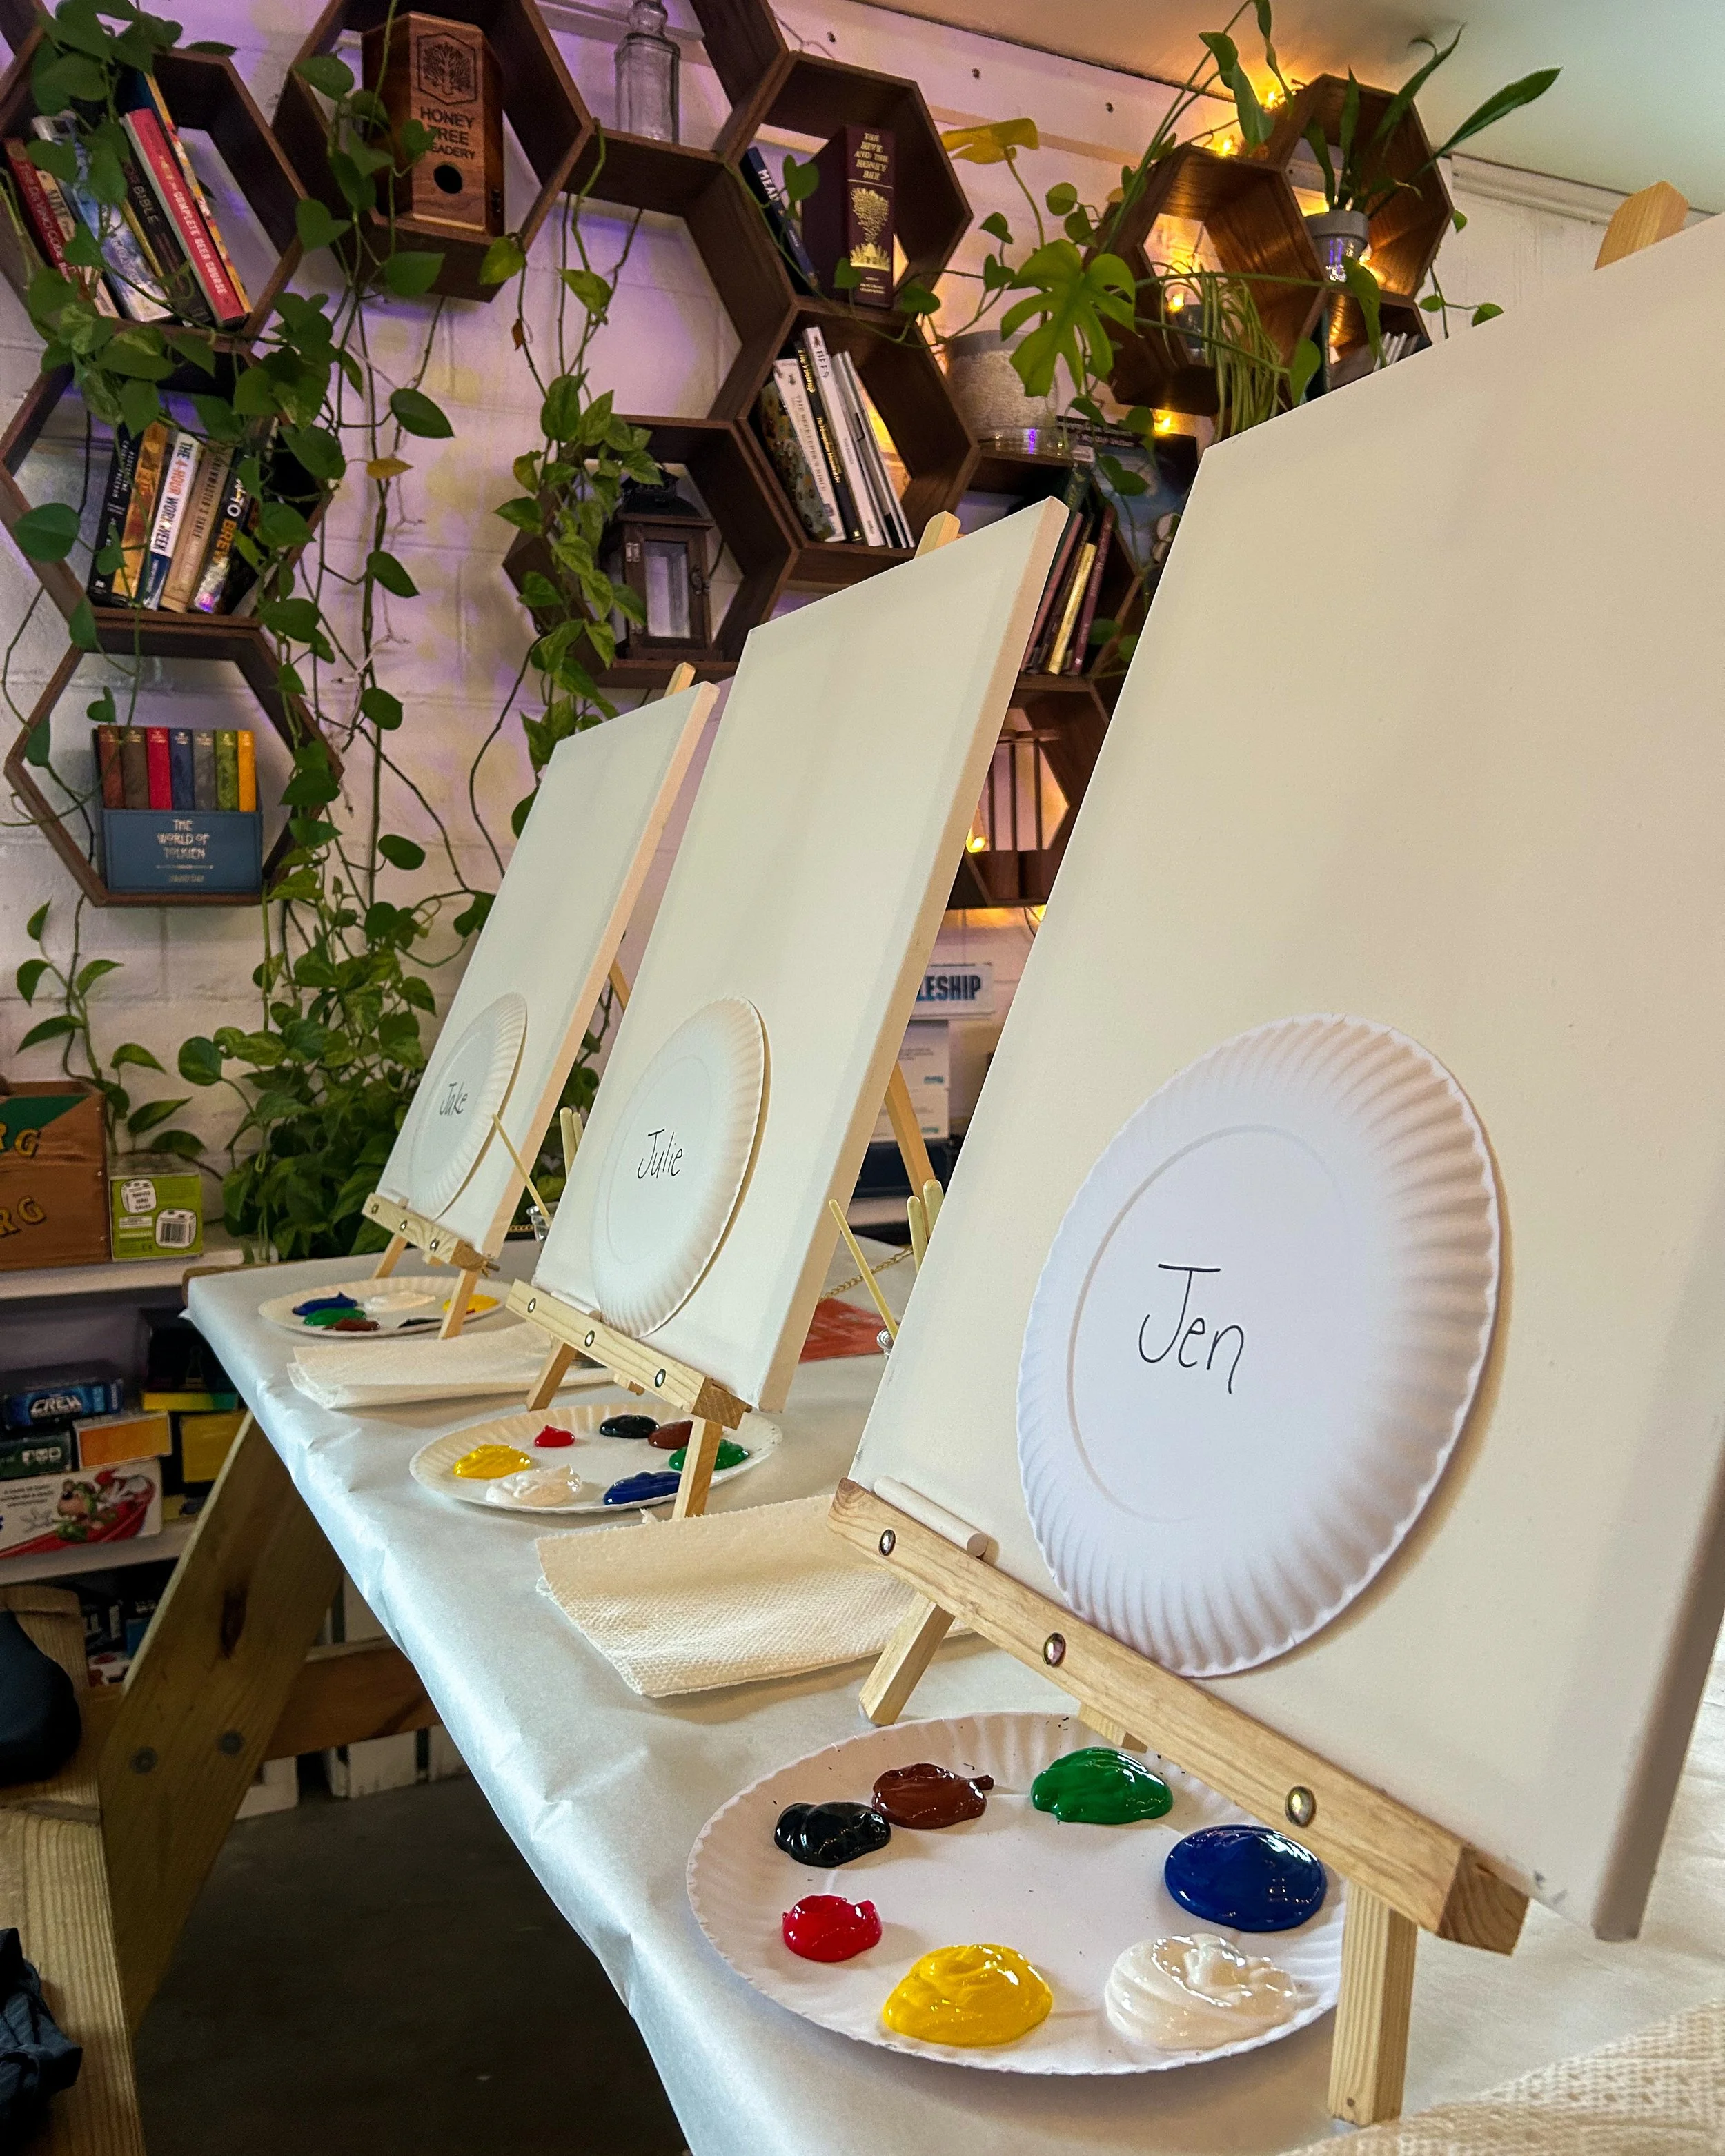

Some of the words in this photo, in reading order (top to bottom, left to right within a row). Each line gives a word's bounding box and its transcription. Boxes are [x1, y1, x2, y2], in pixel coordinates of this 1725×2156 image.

[420, 106, 475, 128] HONEY
[432, 142, 476, 159] EADERY
[854, 150, 872, 159] AND
[132, 185, 160, 225] BIBLE
[174, 191, 200, 237] COMPLETE
[195, 238, 211, 260] BEER
[206, 258, 228, 295] COURSE
[177, 442, 193, 460] THE
[170, 459, 188, 495] 4-HOUR
[213, 518, 237, 563] BREW
[172, 819, 193, 831] THE
[157, 833, 194, 846] WORLD
[195, 833, 210, 846] OF
[163, 847, 206, 860] TOLKIEN
[439, 1081, 469, 1116] Jake
[637, 1128, 683, 1179] Julie
[1138, 1263, 1245, 1394] Jen
[30, 1395, 83, 1415] CREW
